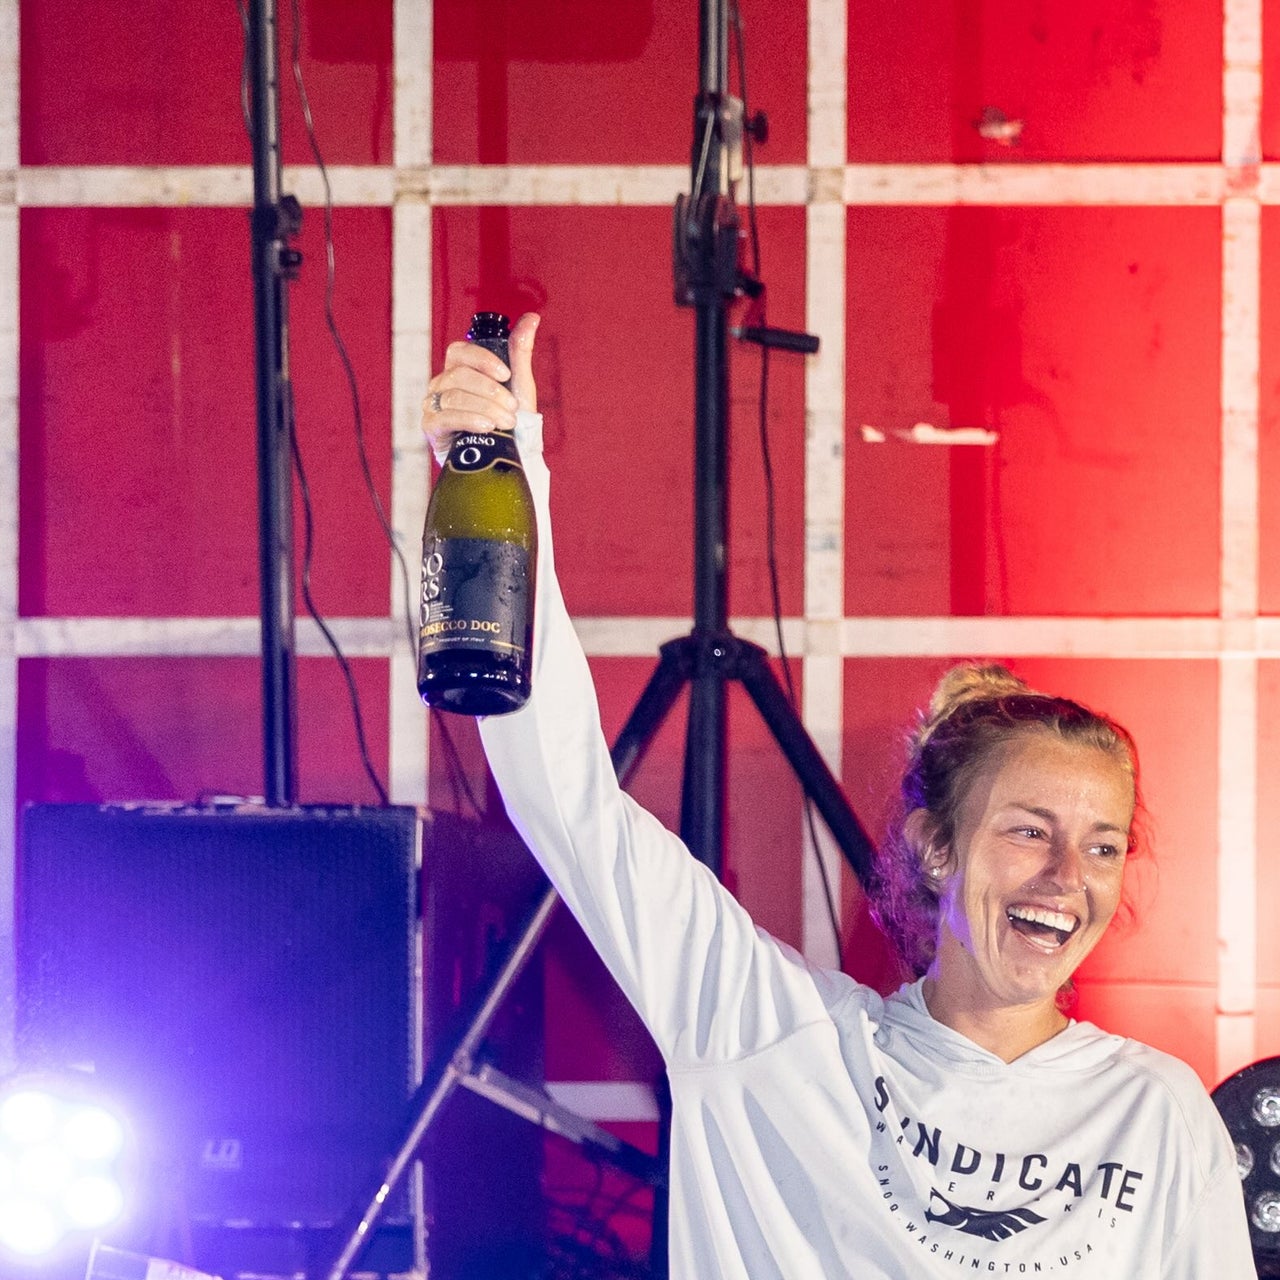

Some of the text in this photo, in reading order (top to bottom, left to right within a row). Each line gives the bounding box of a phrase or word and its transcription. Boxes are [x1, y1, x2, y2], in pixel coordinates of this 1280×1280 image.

[455, 434, 496, 448] SORSO
[460, 447, 481, 464] O
[470, 619, 501, 634] DOC
[874, 1075, 1144, 1213] SNDICATE
